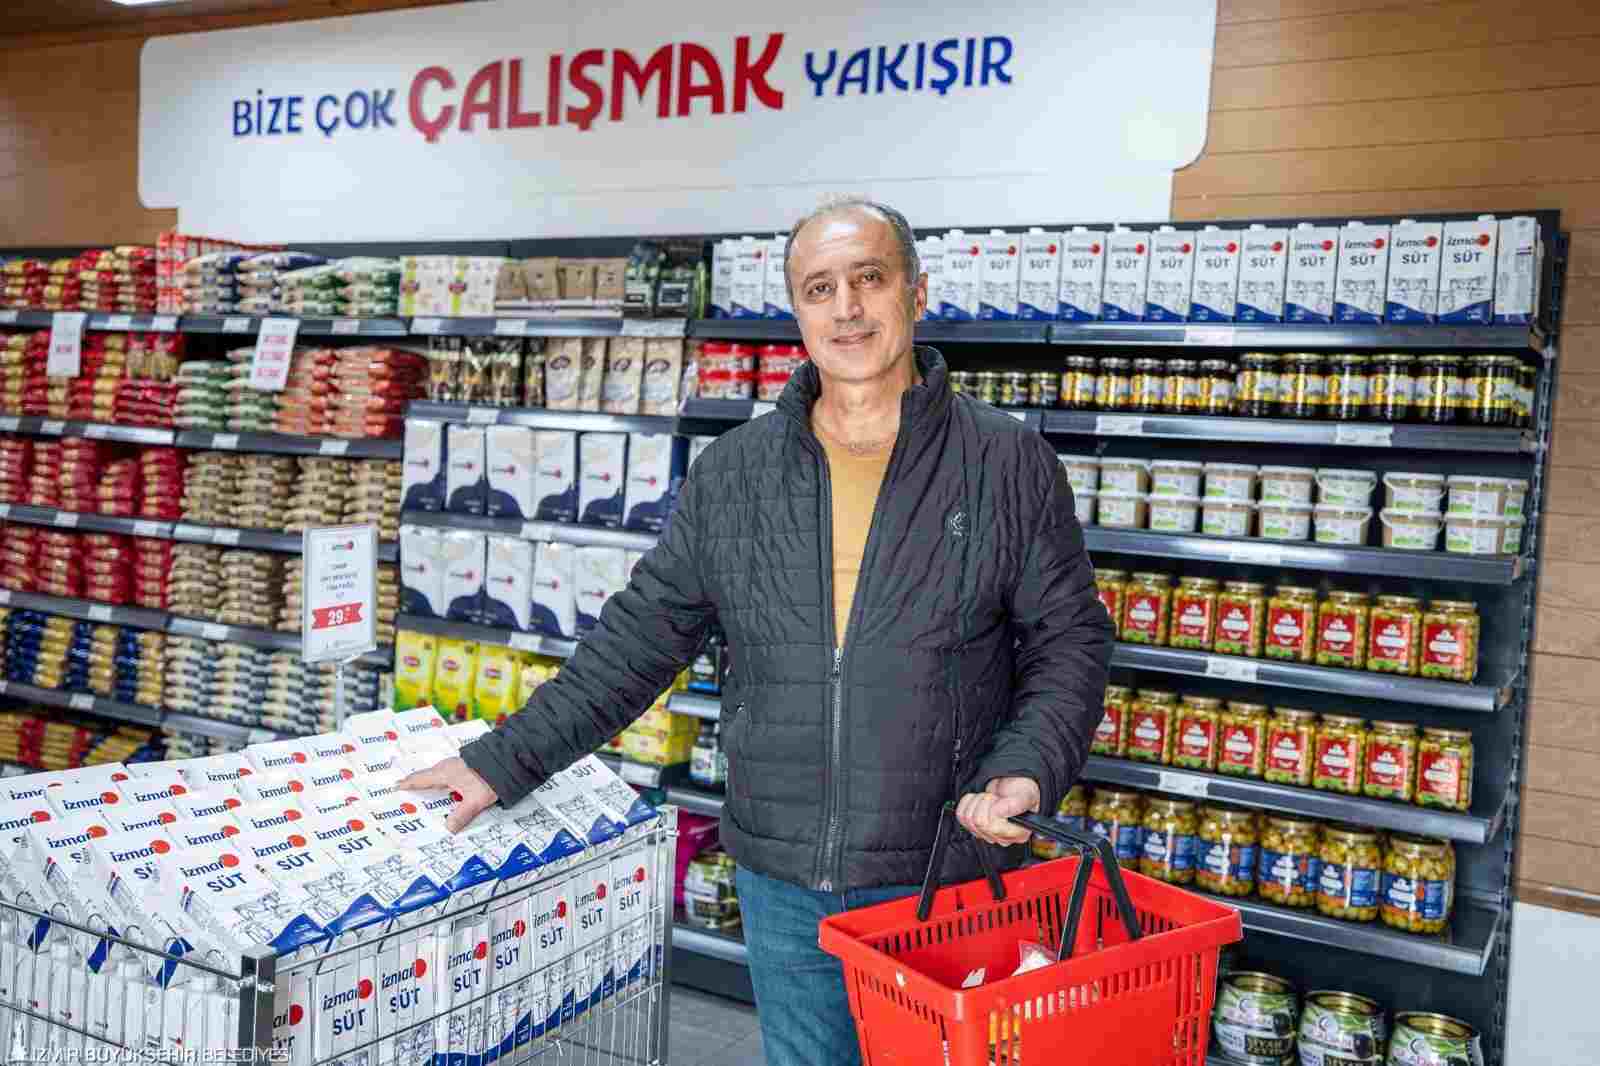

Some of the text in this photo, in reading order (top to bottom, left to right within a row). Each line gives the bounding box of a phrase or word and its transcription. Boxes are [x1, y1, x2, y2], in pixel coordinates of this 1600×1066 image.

[232, 32, 1013, 142] BİZE ÇOK ÇALIŞMAK YAKIŞIR
[1401, 250, 1430, 265] SÜT
[1452, 248, 1481, 264] SÜT
[393, 817, 427, 835] SÜT
[338, 835, 373, 854] SÜT
[276, 851, 315, 871] SÜT
[206, 872, 248, 892] SÜT
[619, 890, 641, 911] SÜT
[581, 908, 604, 930] SÜT
[495, 945, 521, 970] SÜT
[453, 968, 482, 994] SÜT
[389, 987, 421, 1014] SÜT
[333, 1007, 366, 1036] SÜT
